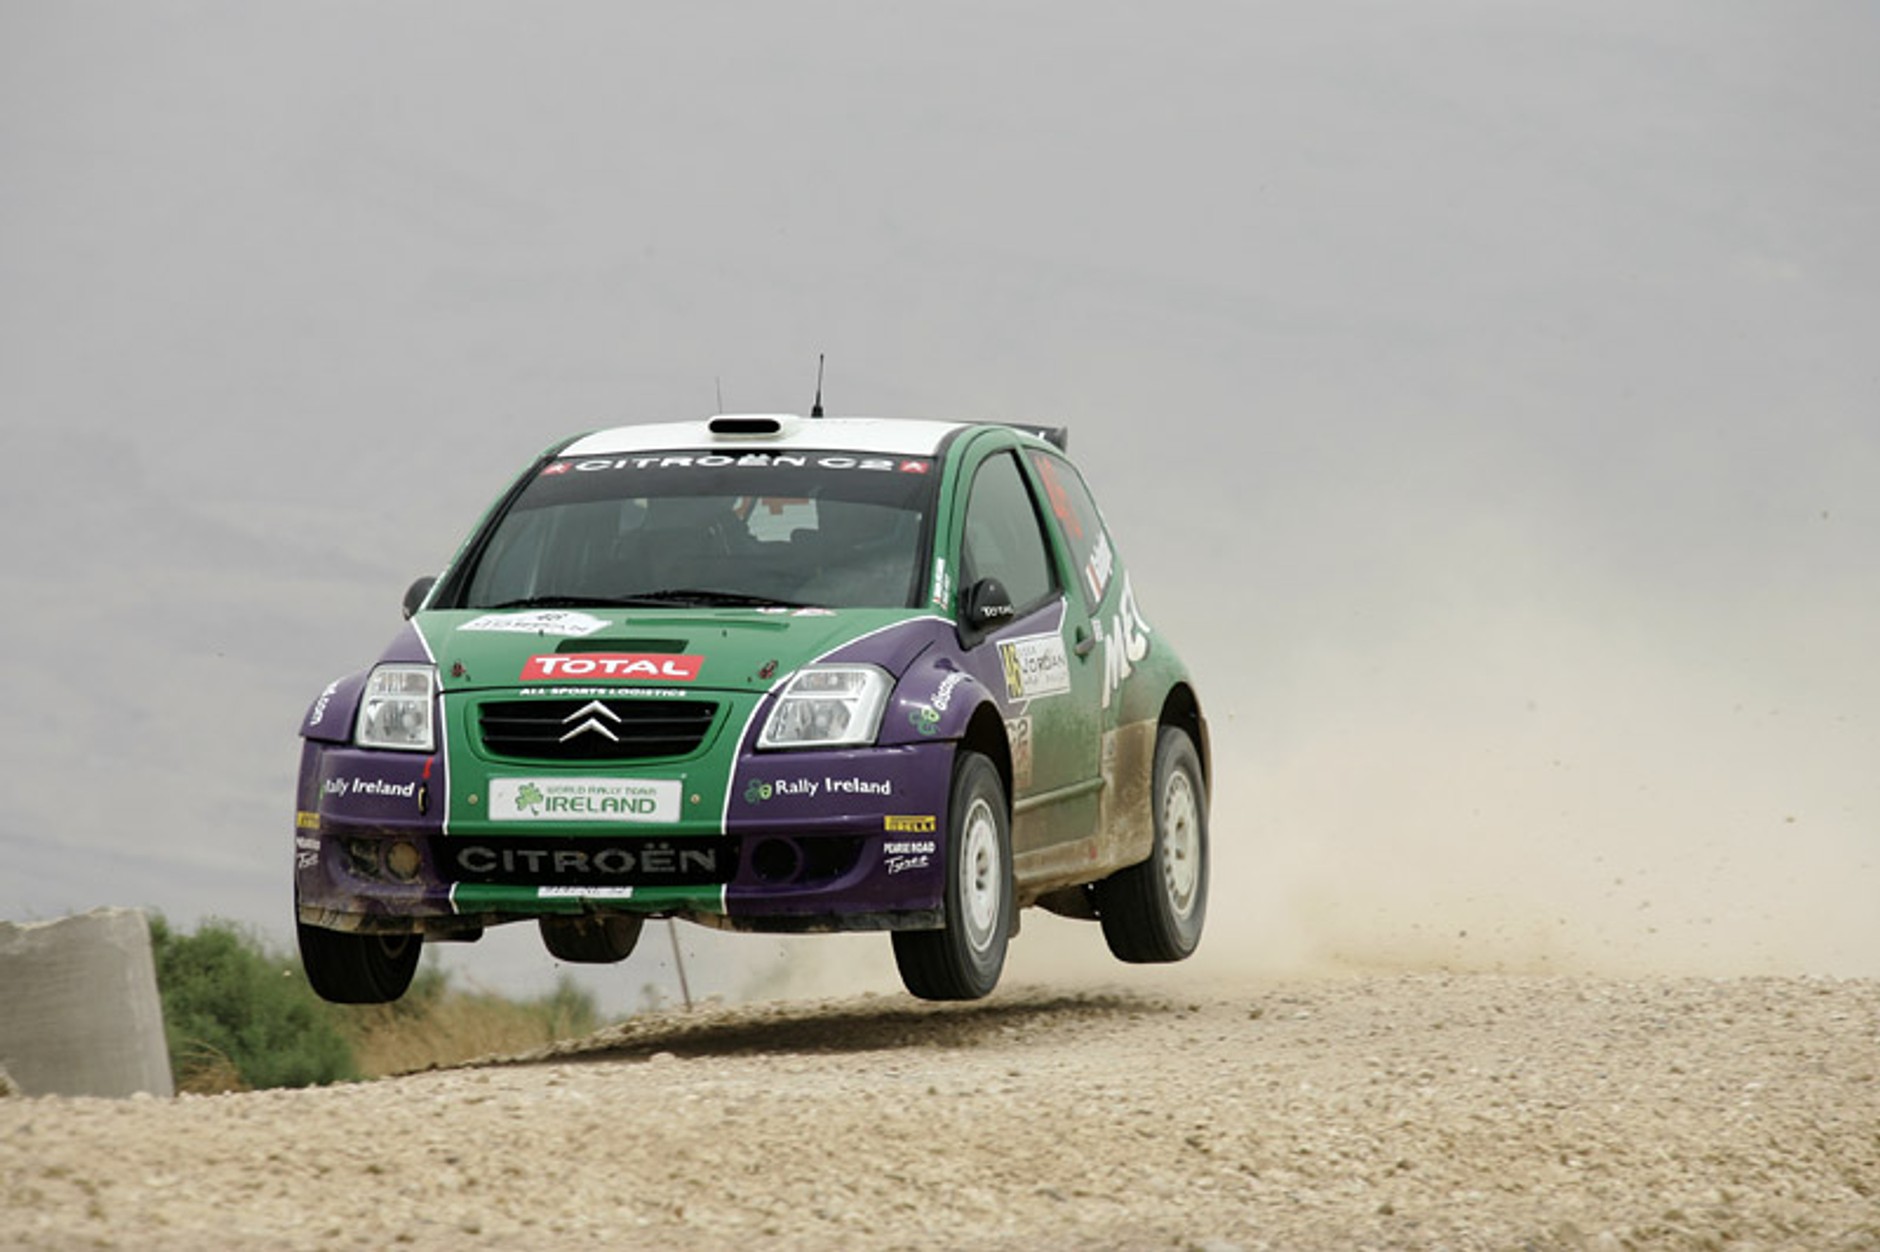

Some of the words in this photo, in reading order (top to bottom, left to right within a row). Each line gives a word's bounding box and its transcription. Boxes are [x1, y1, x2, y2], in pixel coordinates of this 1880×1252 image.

[818, 457, 893, 472] C2
[535, 656, 690, 676] TOTAL
[519, 687, 546, 696] ALL
[550, 687, 606, 696] SPORTS
[609, 688, 687, 697] LOGISTICS
[352, 778, 416, 798] Ireland
[546, 785, 587, 795] WORLD
[590, 786, 623, 795] RALLY
[626, 786, 658, 796] TEAM
[775, 778, 820, 798] Rally
[825, 777, 892, 796] Ireland
[545, 796, 657, 815] IRELAND
[456, 842, 717, 874] CITROËN
